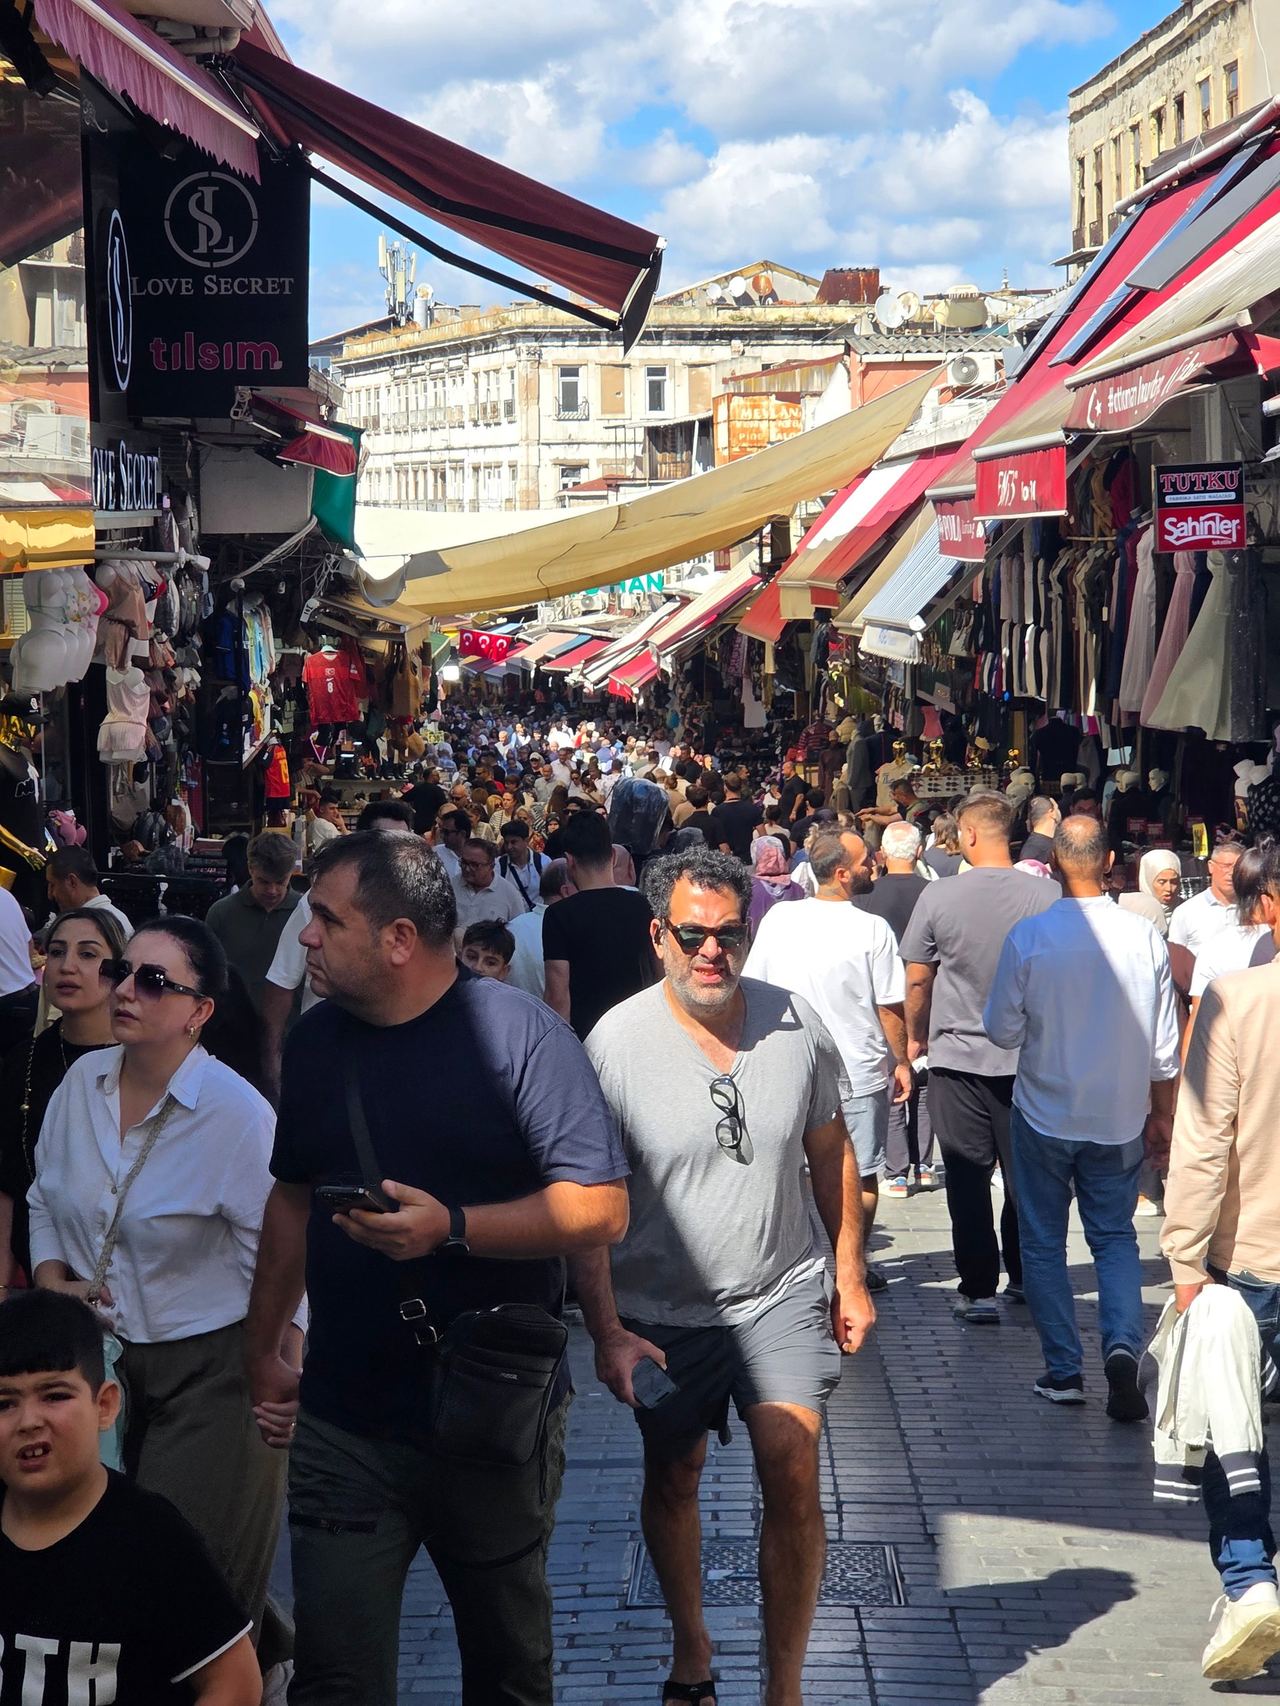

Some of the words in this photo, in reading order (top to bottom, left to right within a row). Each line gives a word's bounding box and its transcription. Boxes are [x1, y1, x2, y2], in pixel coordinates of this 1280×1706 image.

[131, 276, 194, 296] LOVE
[204, 275, 294, 295] SECRET
[120, 440, 158, 510] SECRET
[1160, 470, 1239, 493] TUTKU
[0, 1633, 121, 1706] TH
